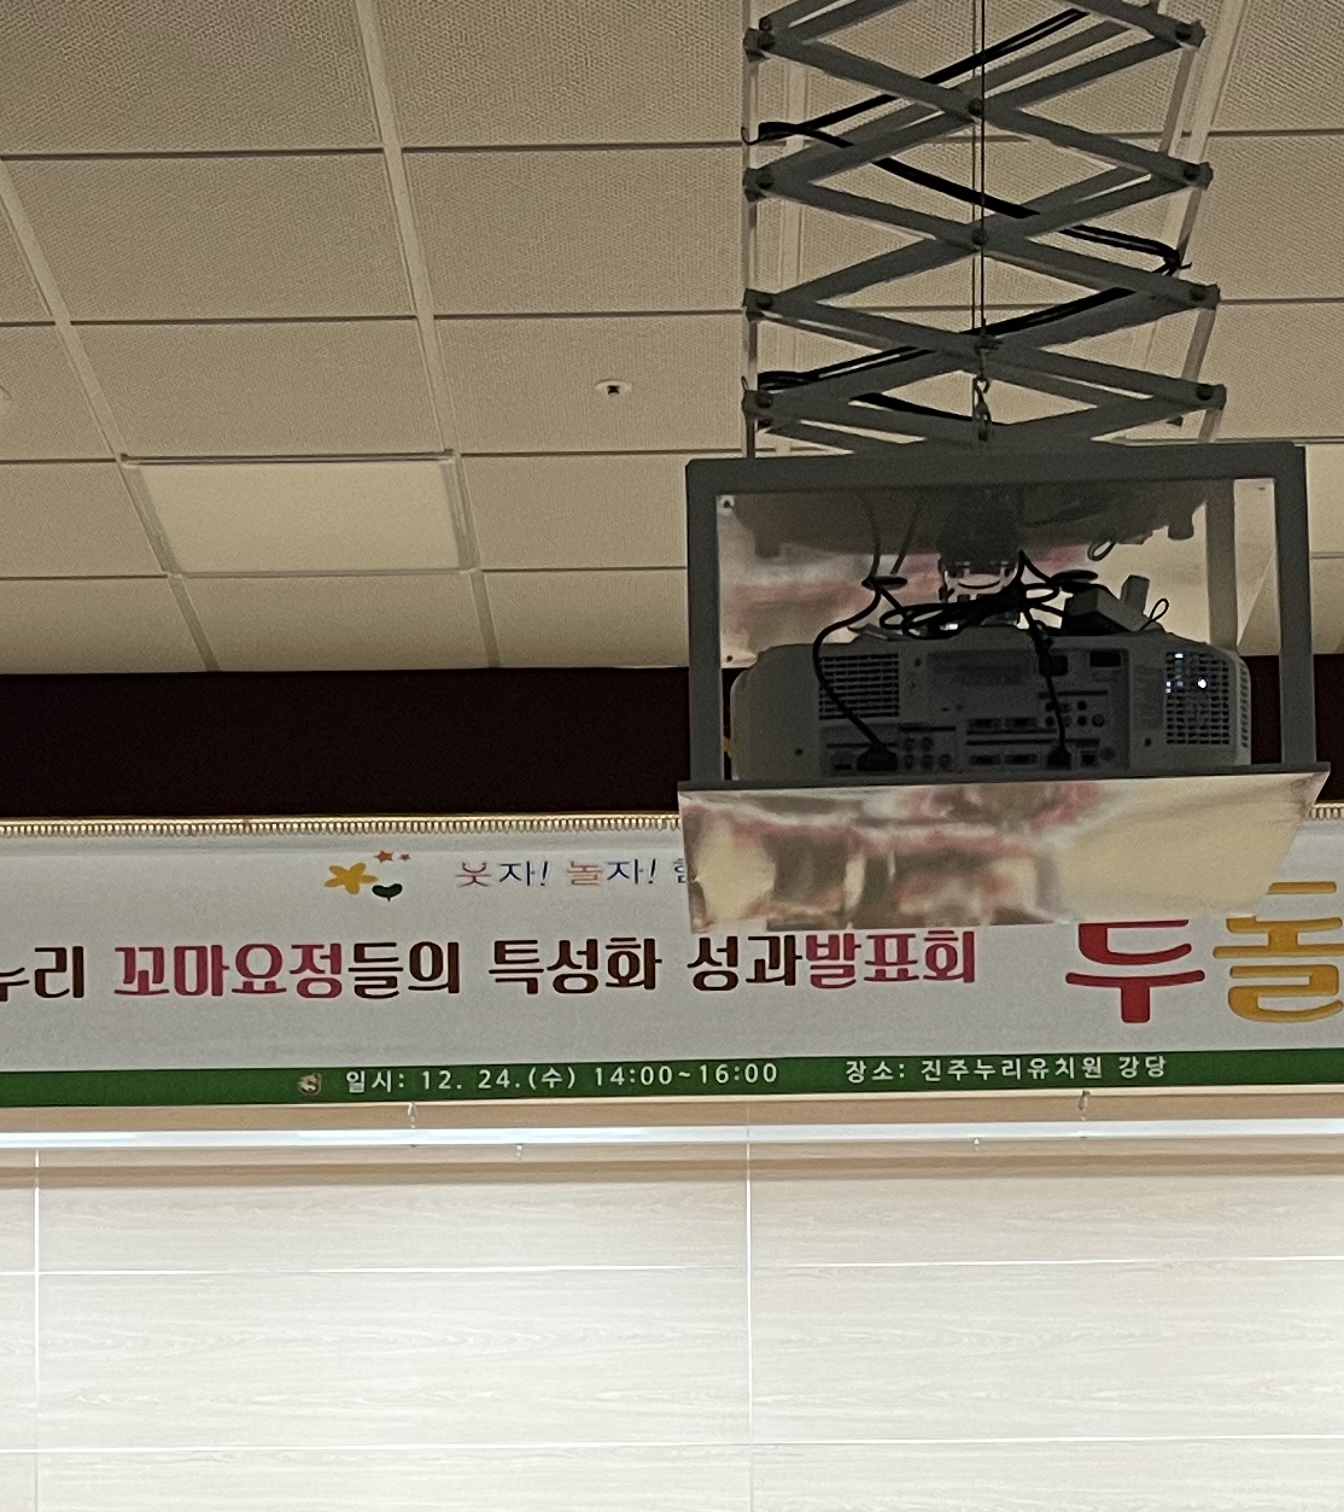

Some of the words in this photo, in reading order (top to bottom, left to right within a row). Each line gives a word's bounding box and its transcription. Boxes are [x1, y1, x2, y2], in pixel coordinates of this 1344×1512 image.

[455, 860, 549, 888] 웃자!
[566, 857, 657, 886] 놀자!
[114, 939, 460, 999] 꼬마요정들의
[488, 936, 662, 995] 특성화
[687, 930, 976, 992] 성과발표회
[346, 1070, 406, 1093] 일시:
[422, 1071, 463, 1090] 12.
[478, 1066, 578, 1092] 24.(수)
[594, 1063, 779, 1087] 14:00~16:00
[845, 1060, 906, 1083] 장소:
[920, 1056, 1103, 1082] 진주누리유치원
[1118, 1055, 1167, 1079] 강당
